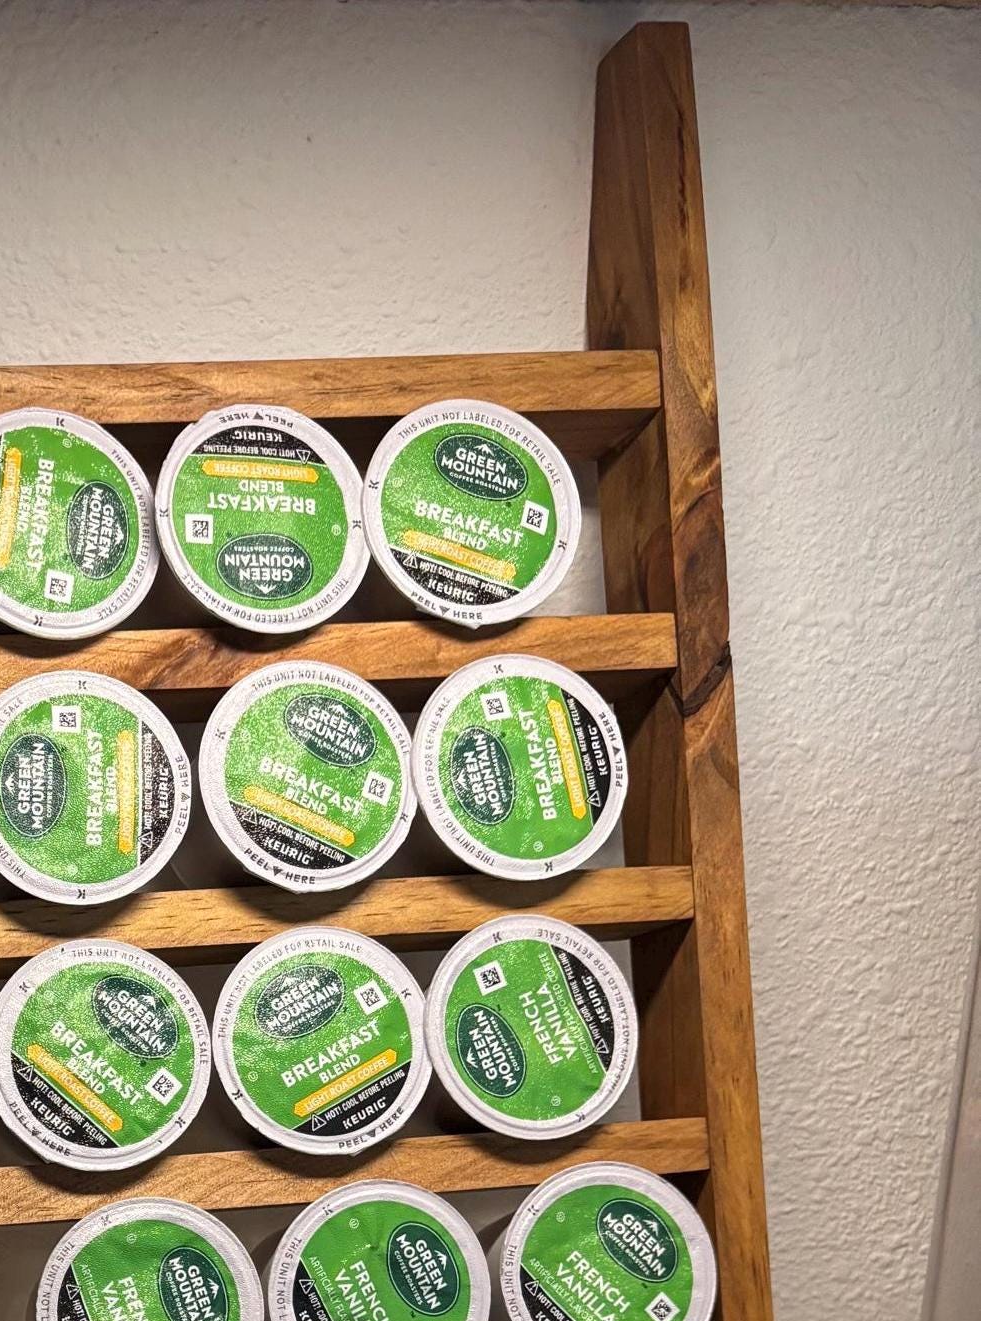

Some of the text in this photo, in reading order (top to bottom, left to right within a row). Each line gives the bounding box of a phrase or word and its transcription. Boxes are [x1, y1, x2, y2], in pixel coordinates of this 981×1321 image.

[236, 430, 281, 440] KEURIG
[440, 455, 520, 490] MOUNTAIN
[454, 446, 507, 474] GREEN
[204, 494, 313, 513] BREAKFAST
[237, 481, 281, 494] BLEND
[15, 490, 32, 538] BLEND
[26, 460, 53, 575] BREAKFAST
[82, 486, 102, 571] MOUNTAIN
[96, 501, 114, 557] GREEN
[413, 500, 523, 547] BREAKFAST
[222, 552, 304, 566] MOUNTAIN
[442, 527, 487, 551] BLEND
[239, 566, 293, 580] GREEN
[426, 580, 474, 602] KEURIG
[410, 591, 483, 620] PEEL HERE
[290, 711, 369, 758] MOUNTAIN
[306, 704, 358, 739] GREEN
[515, 707, 558, 818] BREAKFAST
[540, 737, 562, 781] BLEND
[589, 728, 608, 774] KEURIG
[598, 712, 623, 783] PEEL HERE
[18, 756, 32, 814] GREEN
[32, 740, 45, 828] MOUNTAIN
[85, 728, 101, 846] BREAKFAST
[104, 763, 116, 811] BLEND
[159, 767, 168, 817] KEURIG
[175, 756, 188, 833] PEEL HERE
[257, 754, 366, 815] BREAKFAST
[464, 750, 488, 806] GREEN
[471, 733, 504, 815] MOUNTAIN
[284, 786, 330, 815] BLEND
[243, 848, 316, 884] PEEL HERE
[263, 838, 311, 864] KEURIG
[114, 987, 163, 1033] GREEN
[266, 979, 341, 1032] MOUNTAIN
[269, 977, 321, 1013] GREEN
[582, 974, 609, 1022] KEURIG
[96, 990, 168, 1053] MOUNTAIN
[519, 990, 561, 1064] FRENCH
[533, 981, 577, 1059] VANILLA
[49, 1020, 147, 1106] BREAKFAST
[281, 1017, 381, 1088] BREAKFAST
[318, 1050, 360, 1082] BLEND
[467, 1027, 499, 1080] GREEN
[472, 1009, 517, 1086] MOUNTAIN
[66, 1057, 109, 1095] BLEND
[325, 1069, 404, 1121] HOT! COOL BEFORE PEELING
[29, 1098, 72, 1136] KEURIG
[340, 1104, 404, 1149] PEEL HERE
[343, 1098, 386, 1130] KEURIG
[601, 1212, 667, 1276] MOUNTAIN
[620, 1211, 667, 1256] GREEN
[393, 1250, 423, 1305] COFFEE ROASTERS
[394, 1233, 441, 1310] MOUNTAIN
[413, 1238, 447, 1290] GREEN
[567, 1249, 629, 1313] FRENCH
[186, 1264, 216, 1318] GREEN
[307, 1291, 321, 1310] HOT!
